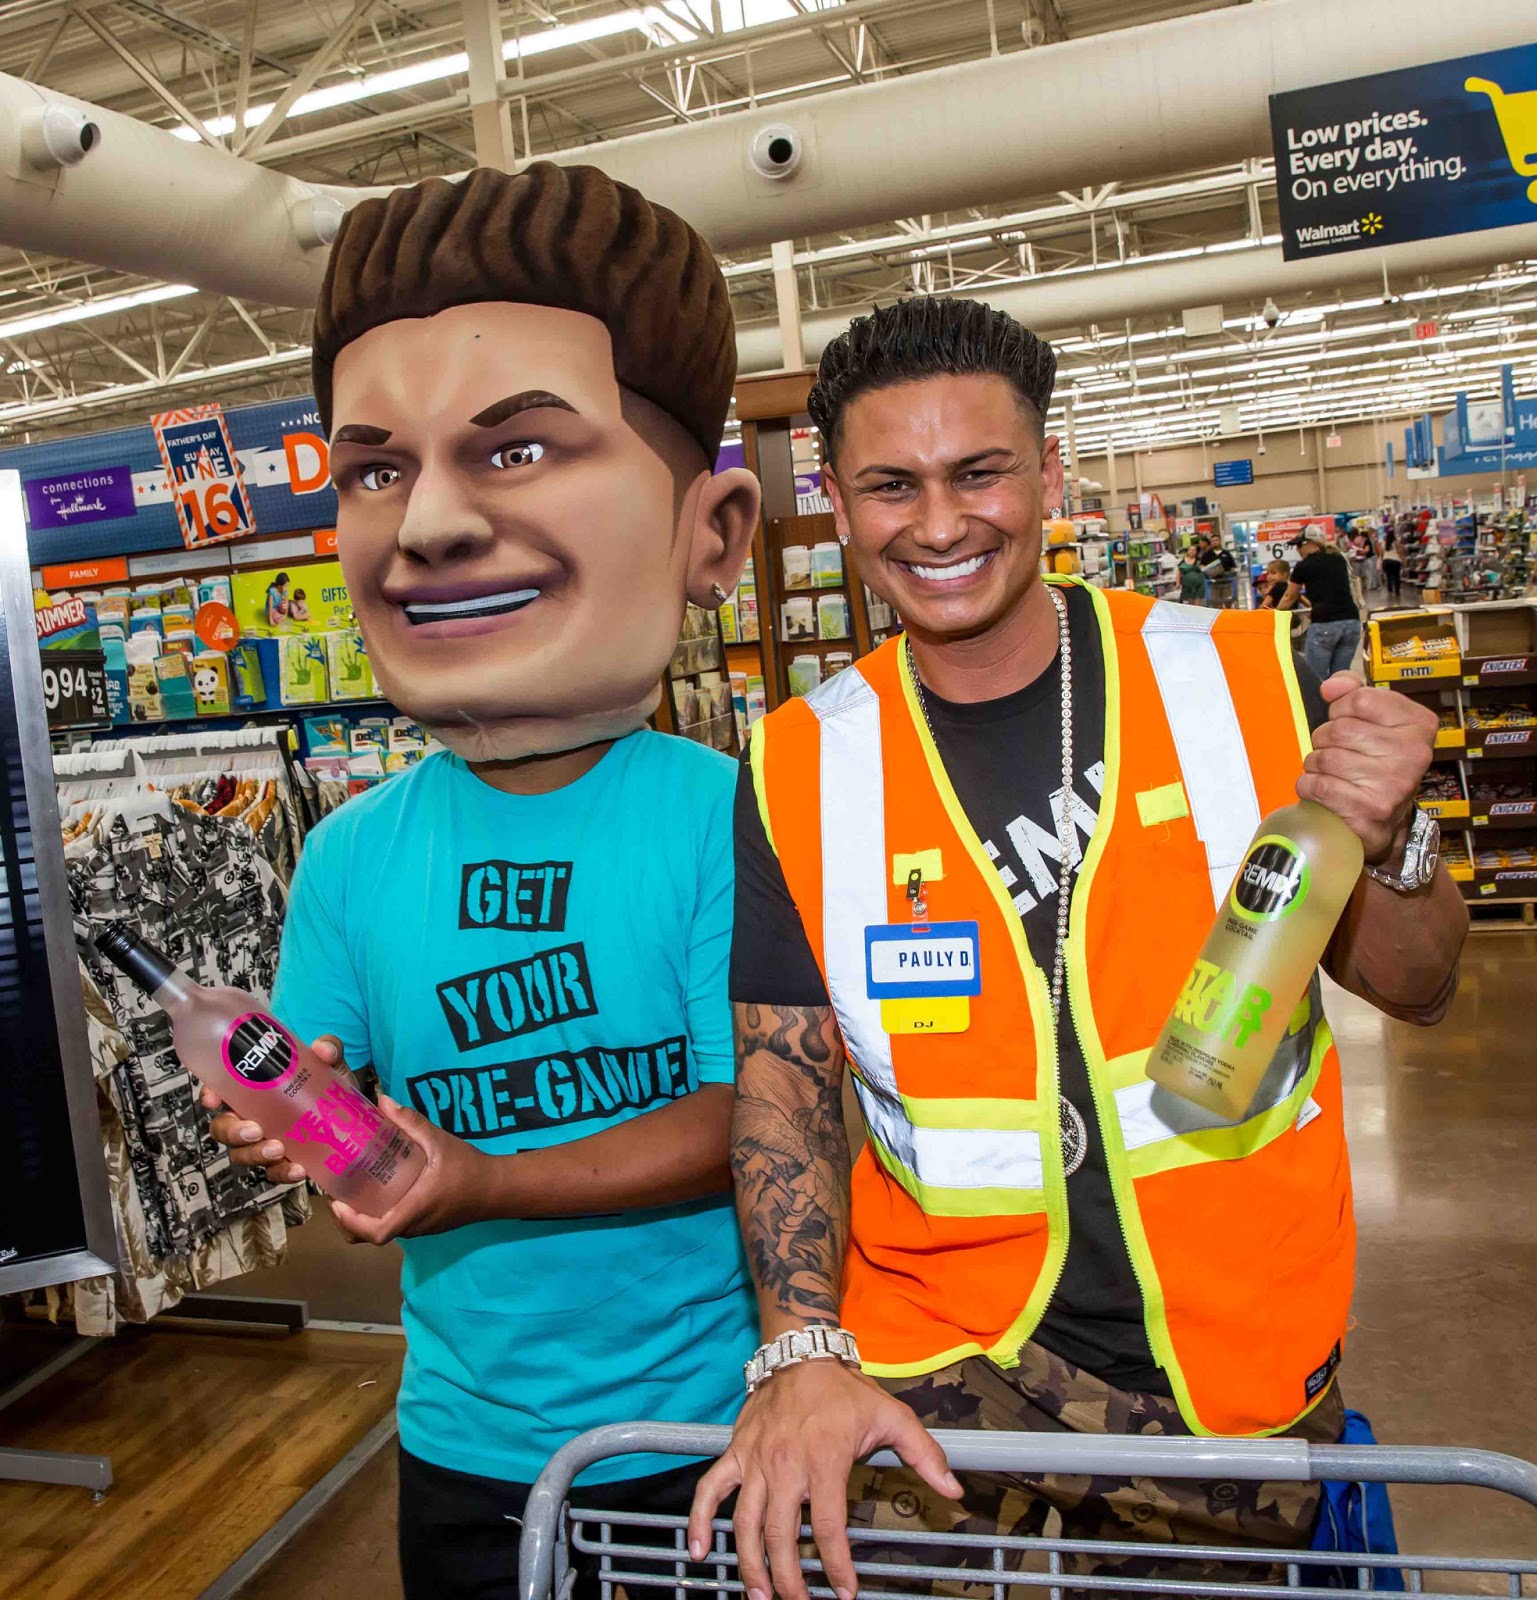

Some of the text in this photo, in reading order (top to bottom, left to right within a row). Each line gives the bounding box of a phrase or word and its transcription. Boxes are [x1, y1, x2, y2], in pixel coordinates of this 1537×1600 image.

[1287, 109, 1428, 150] Low prices.
[1289, 137, 1418, 175] Every day.
[1291, 156, 1467, 201] On everything.
[1296, 219, 1361, 243] Walmart
[167, 431, 218, 448] FATHER'S DAY
[175, 457, 229, 487] JUNE
[42, 475, 114, 494] connections
[57, 497, 106, 520] Hallmark
[181, 483, 239, 541] 16
[69, 568, 99, 580] FAMILY
[322, 587, 348, 602] GIFTS
[36, 599, 87, 637] SUMMER
[1484, 661, 1523, 672] SNICKERS
[91, 687, 104, 705] $2
[1488, 732, 1529, 743] SNICKERS
[1493, 805, 1532, 814] SNICKERS
[466, 865, 566, 925] GET
[899, 951, 953, 967] PAULY
[441, 951, 589, 1042] YOUR
[235, 1025, 283, 1078] REMIX
[415, 1042, 689, 1133] PRE-GAME
